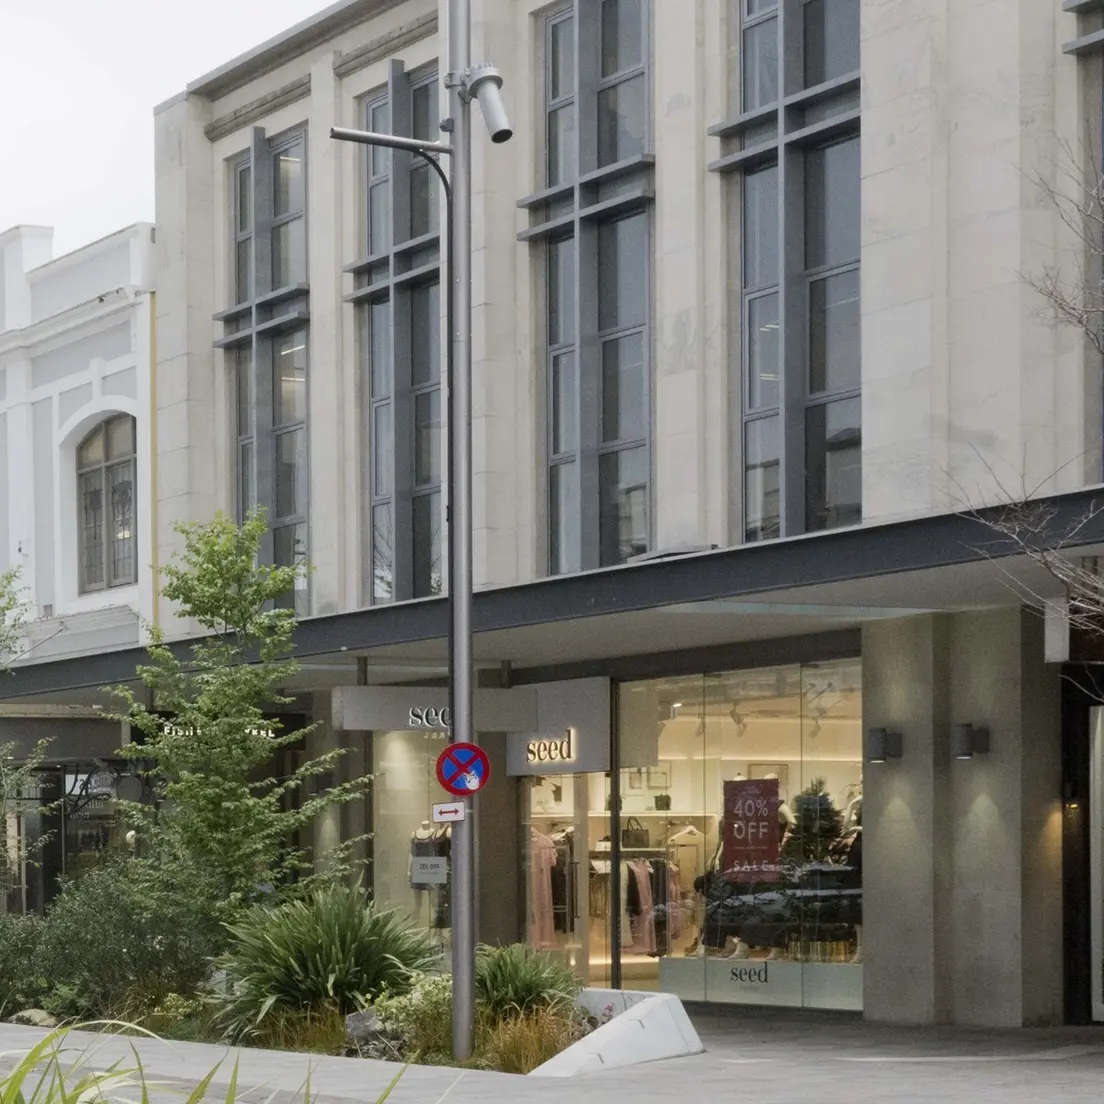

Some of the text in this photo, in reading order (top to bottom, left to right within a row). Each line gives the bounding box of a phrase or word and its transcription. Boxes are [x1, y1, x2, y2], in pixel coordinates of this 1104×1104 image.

[527, 729, 573, 762] seed
[733, 799, 769, 817] 40%
[733, 821, 769, 840] OFF
[730, 961, 769, 983] seed
